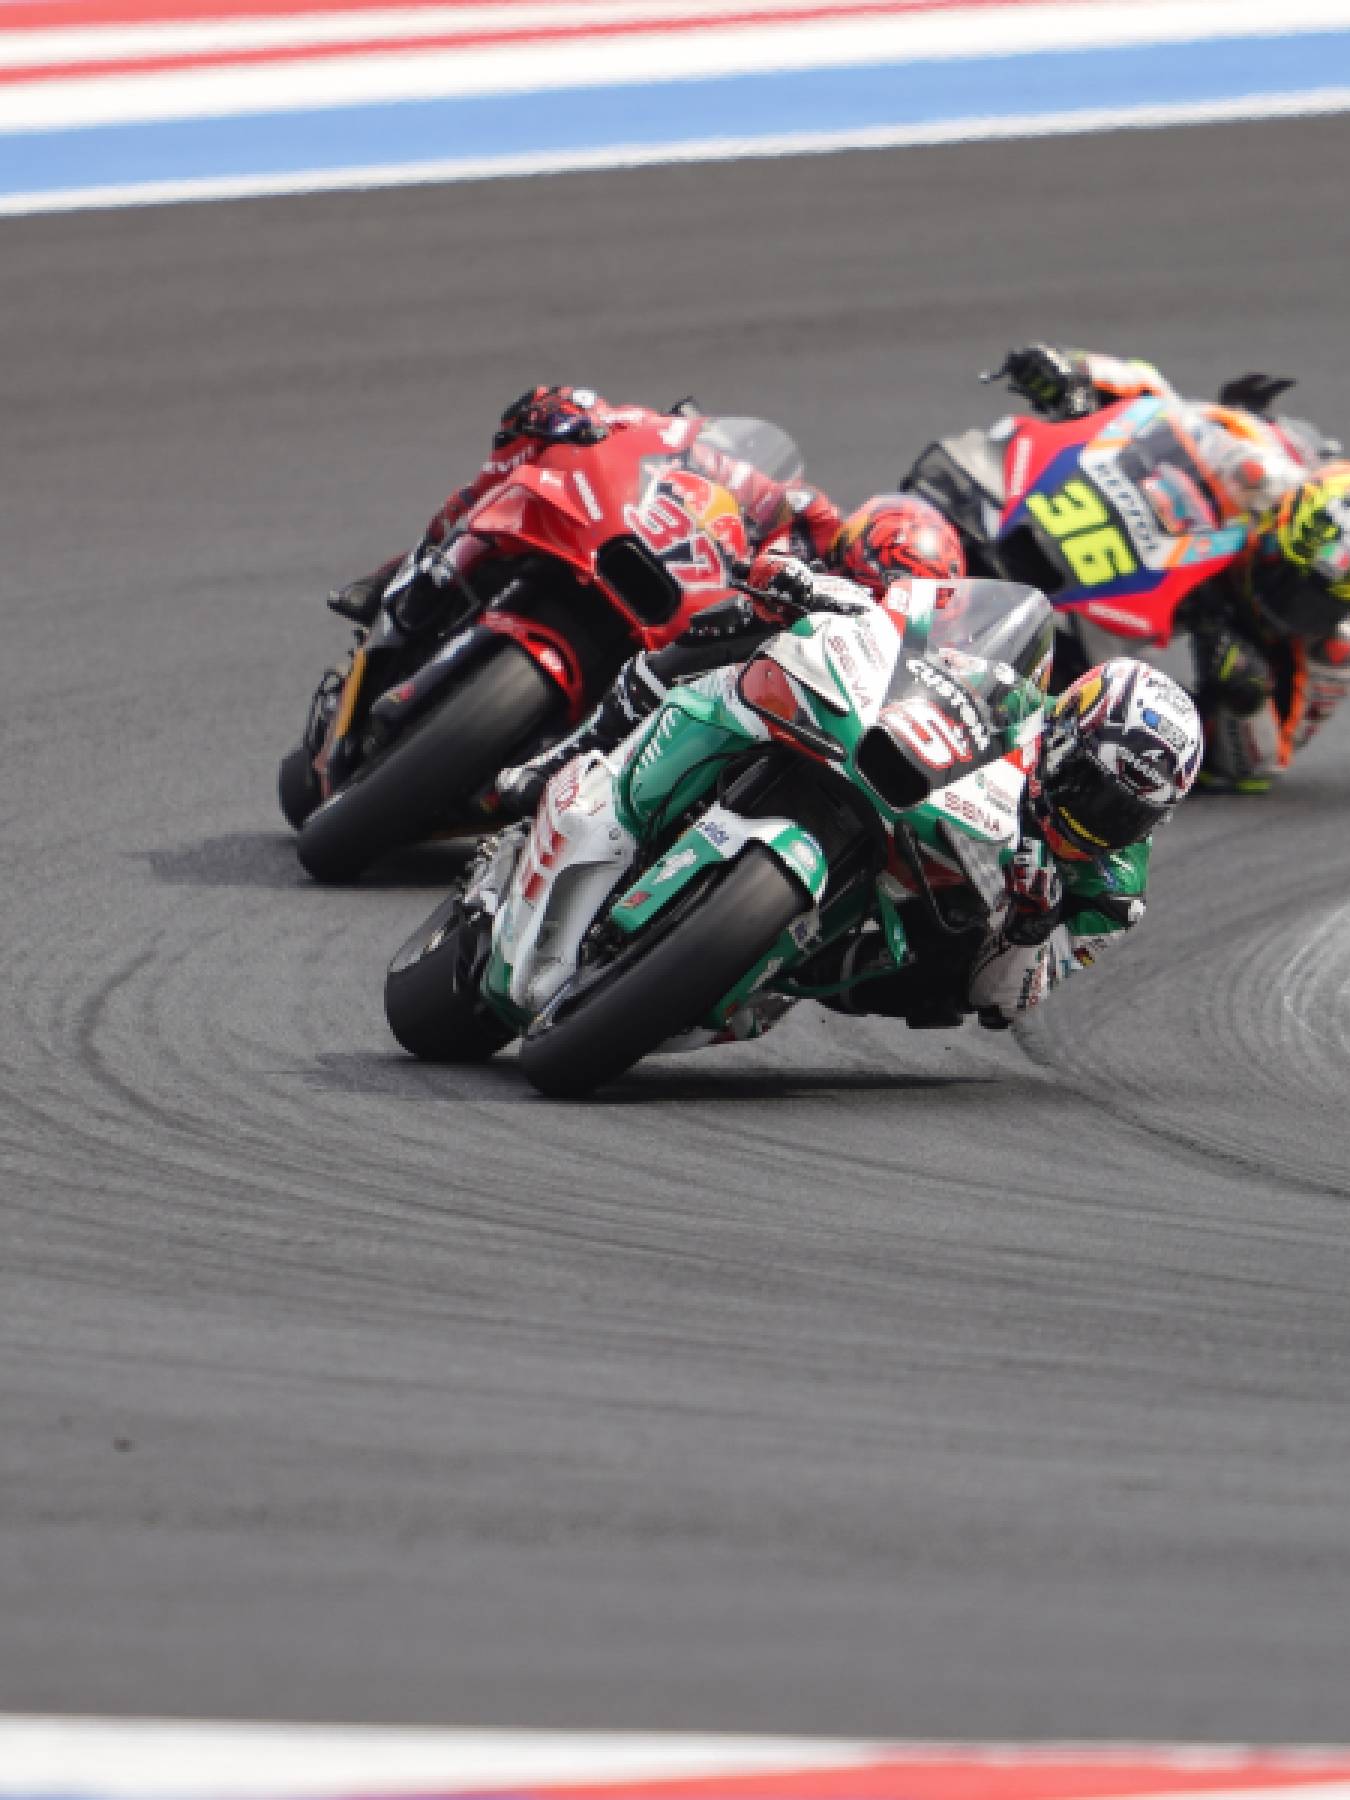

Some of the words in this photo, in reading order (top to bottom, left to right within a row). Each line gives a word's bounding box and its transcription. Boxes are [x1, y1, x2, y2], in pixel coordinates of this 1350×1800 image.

[623, 496, 727, 590] 37
[1026, 479, 1138, 586] 36
[879, 697, 973, 768] 5
